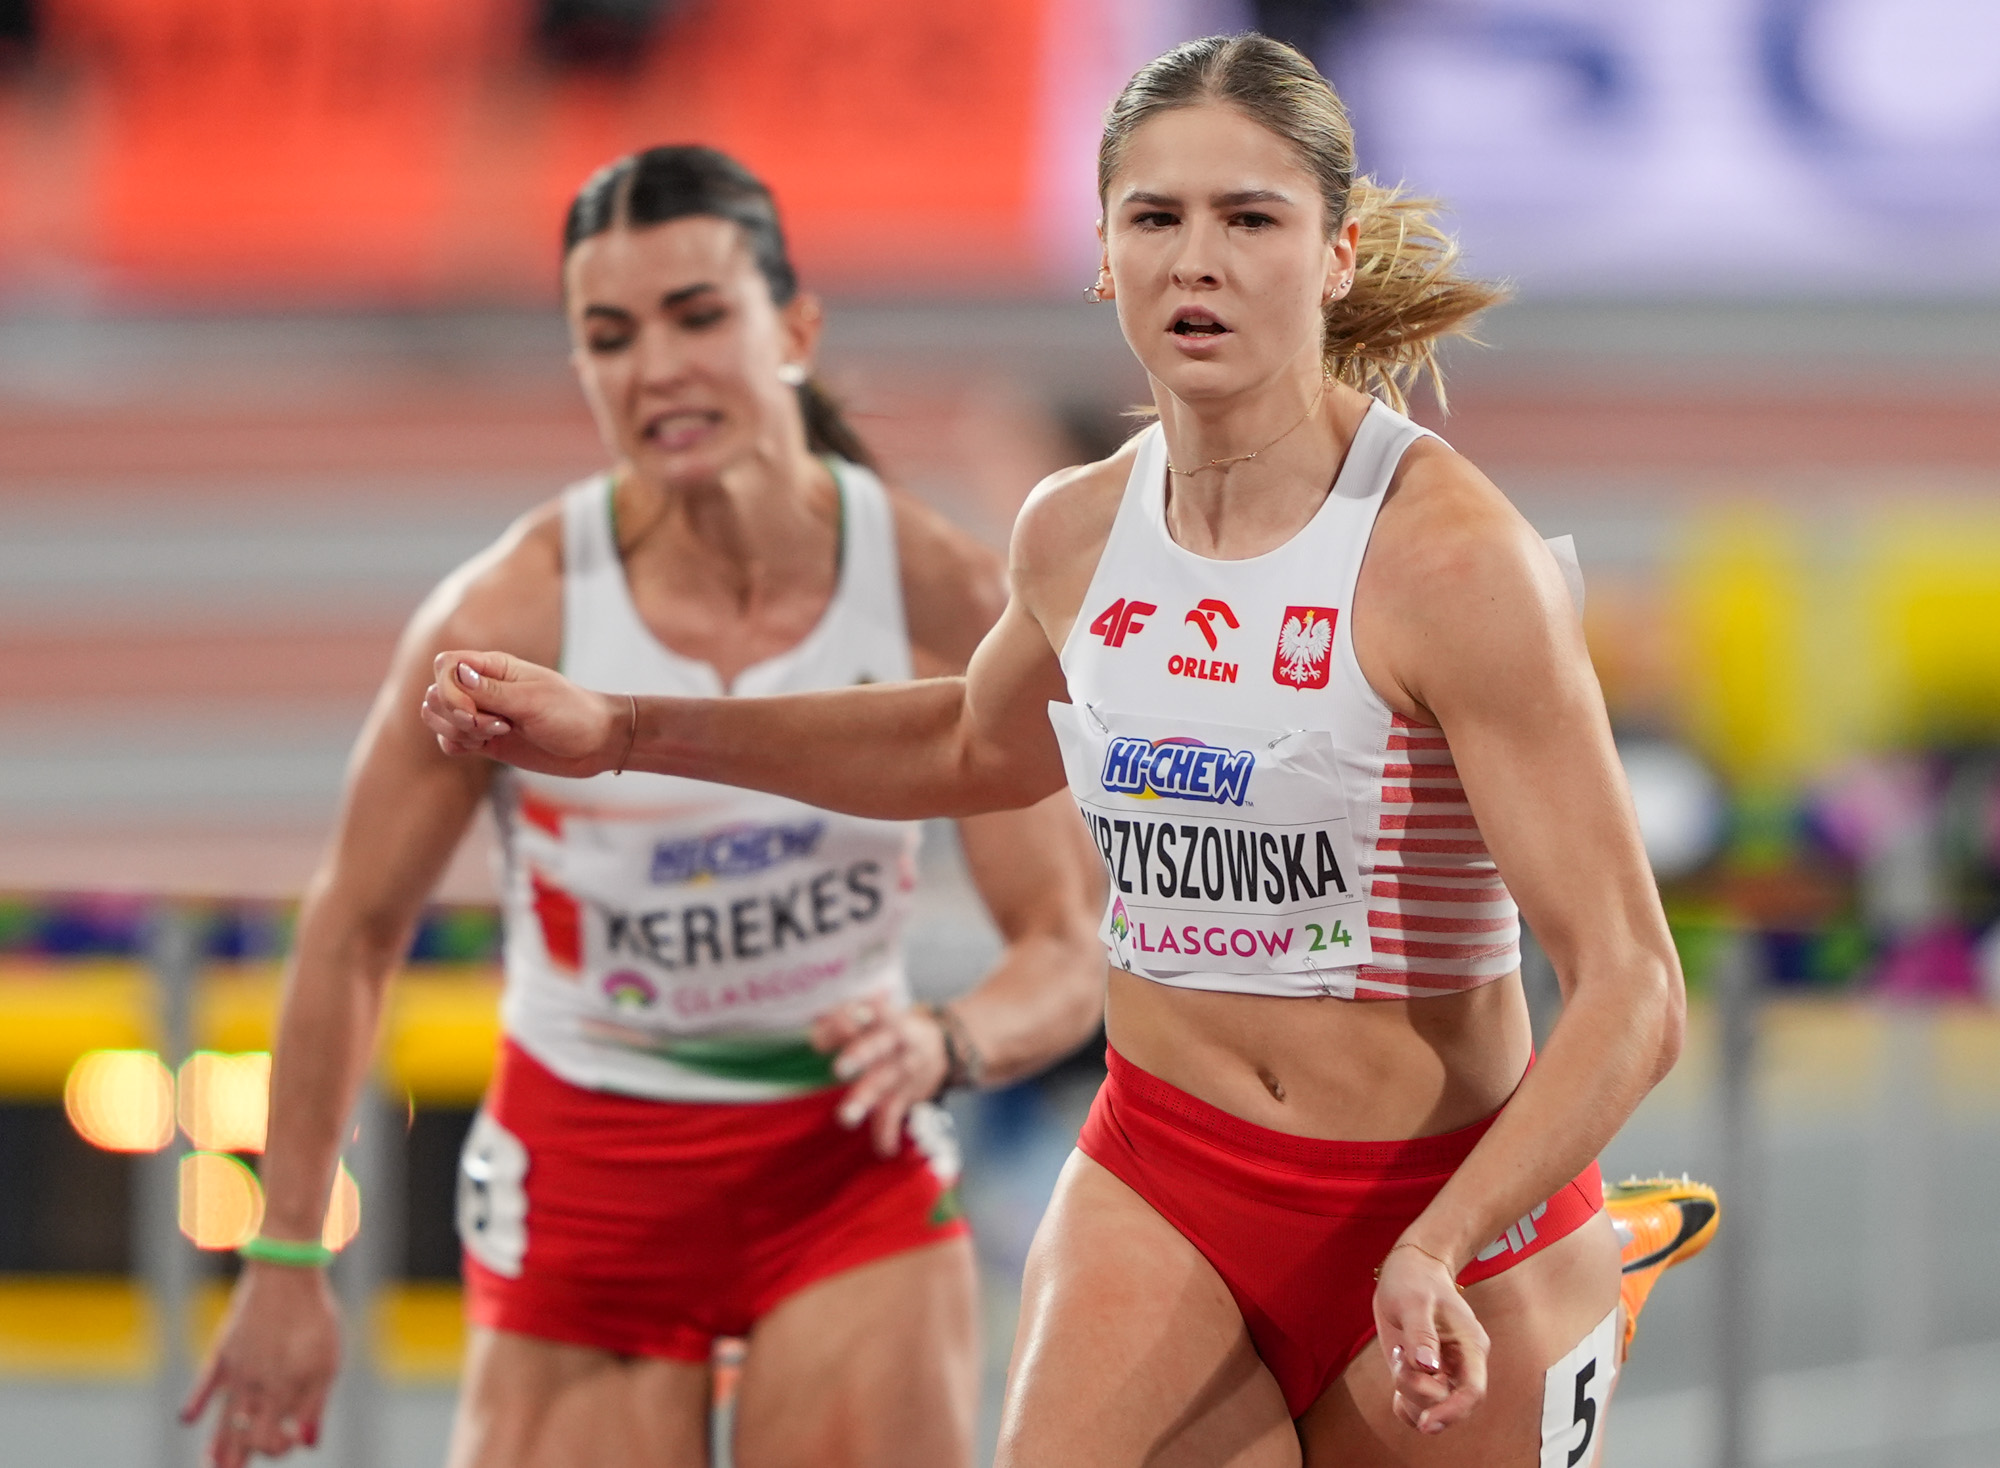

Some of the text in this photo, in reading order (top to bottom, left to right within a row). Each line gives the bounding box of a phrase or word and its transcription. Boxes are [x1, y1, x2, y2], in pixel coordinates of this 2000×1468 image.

[1089, 598, 1157, 648] 4F
[1167, 654, 1239, 684] ORLEN
[1101, 736, 1256, 807] HI-CHEW
[1081, 806, 1347, 904] RZYSZOWSKA
[606, 860, 884, 969] KEREKES
[1130, 919, 1352, 957] LASGOW 24
[1567, 1357, 1596, 1468] 5
